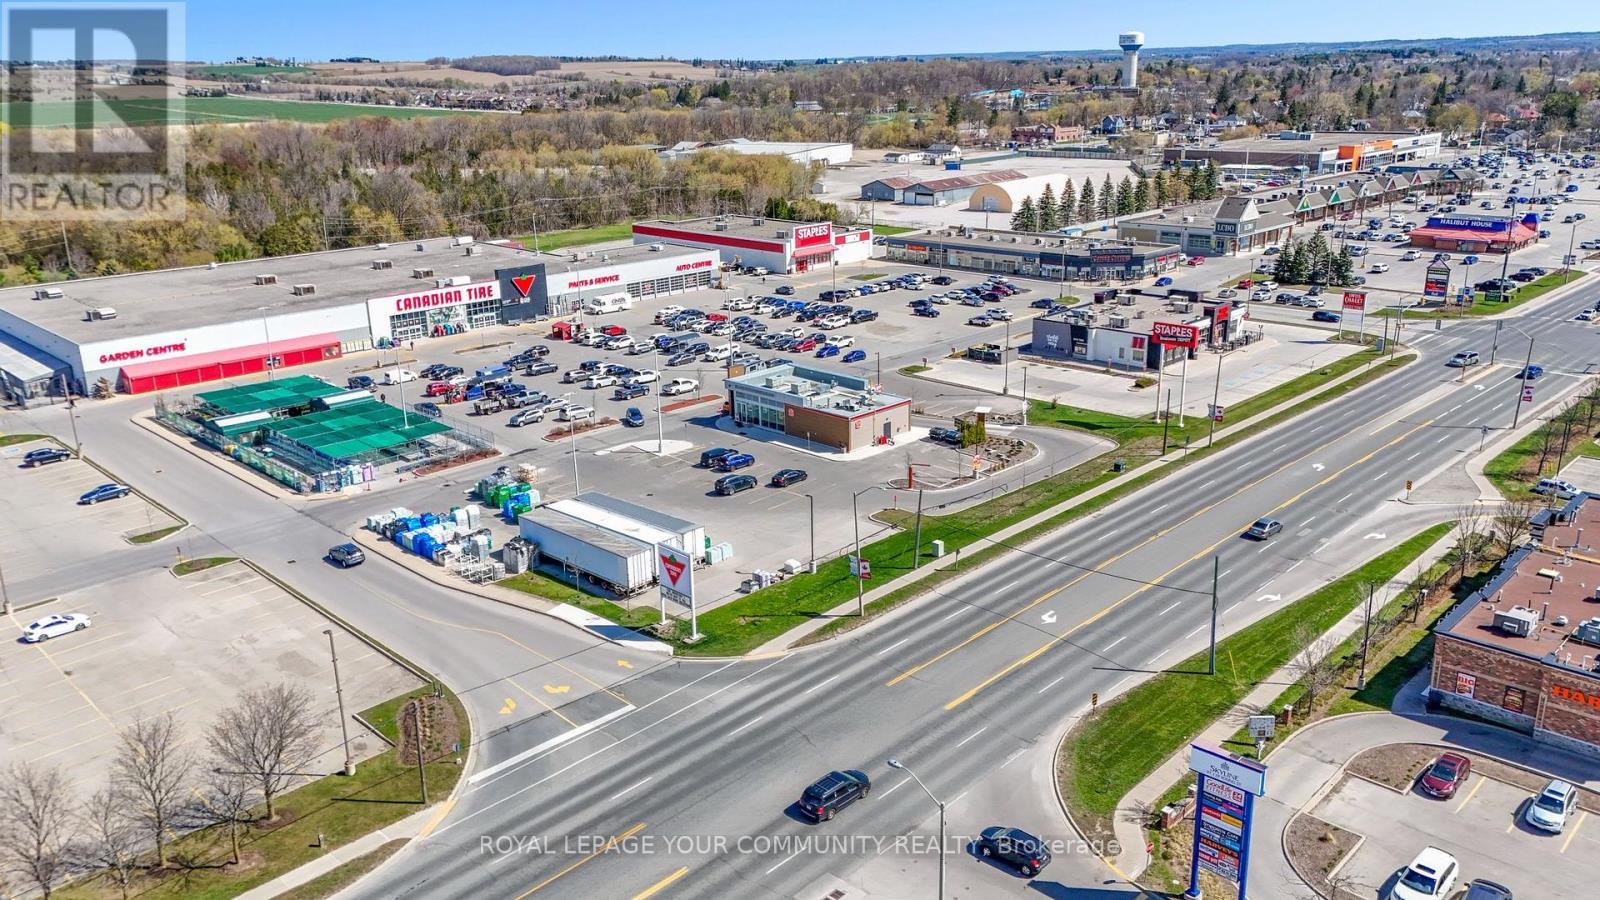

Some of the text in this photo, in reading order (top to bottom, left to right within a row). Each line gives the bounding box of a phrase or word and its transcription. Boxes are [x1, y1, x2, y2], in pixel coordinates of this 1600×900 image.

[1217, 224, 1235, 232] LCBO
[1440, 219, 1468, 227] HALIBUT
[798, 226, 828, 239] STAPLES
[675, 260, 713, 272] AUTO CENTRE
[568, 279, 589, 289] PARTS
[594, 275, 620, 285] SERVICE
[396, 285, 494, 312] CANADIAN TIRE
[1344, 296, 1363, 304] CHALET
[1154, 324, 1193, 337] STAPLES
[100, 343, 186, 363] GARDEN CENTRE
[1210, 765, 1239, 782] SKYLINE
[1206, 778, 1232, 792] GoodLife
[1205, 785, 1232, 799] FITNESS
